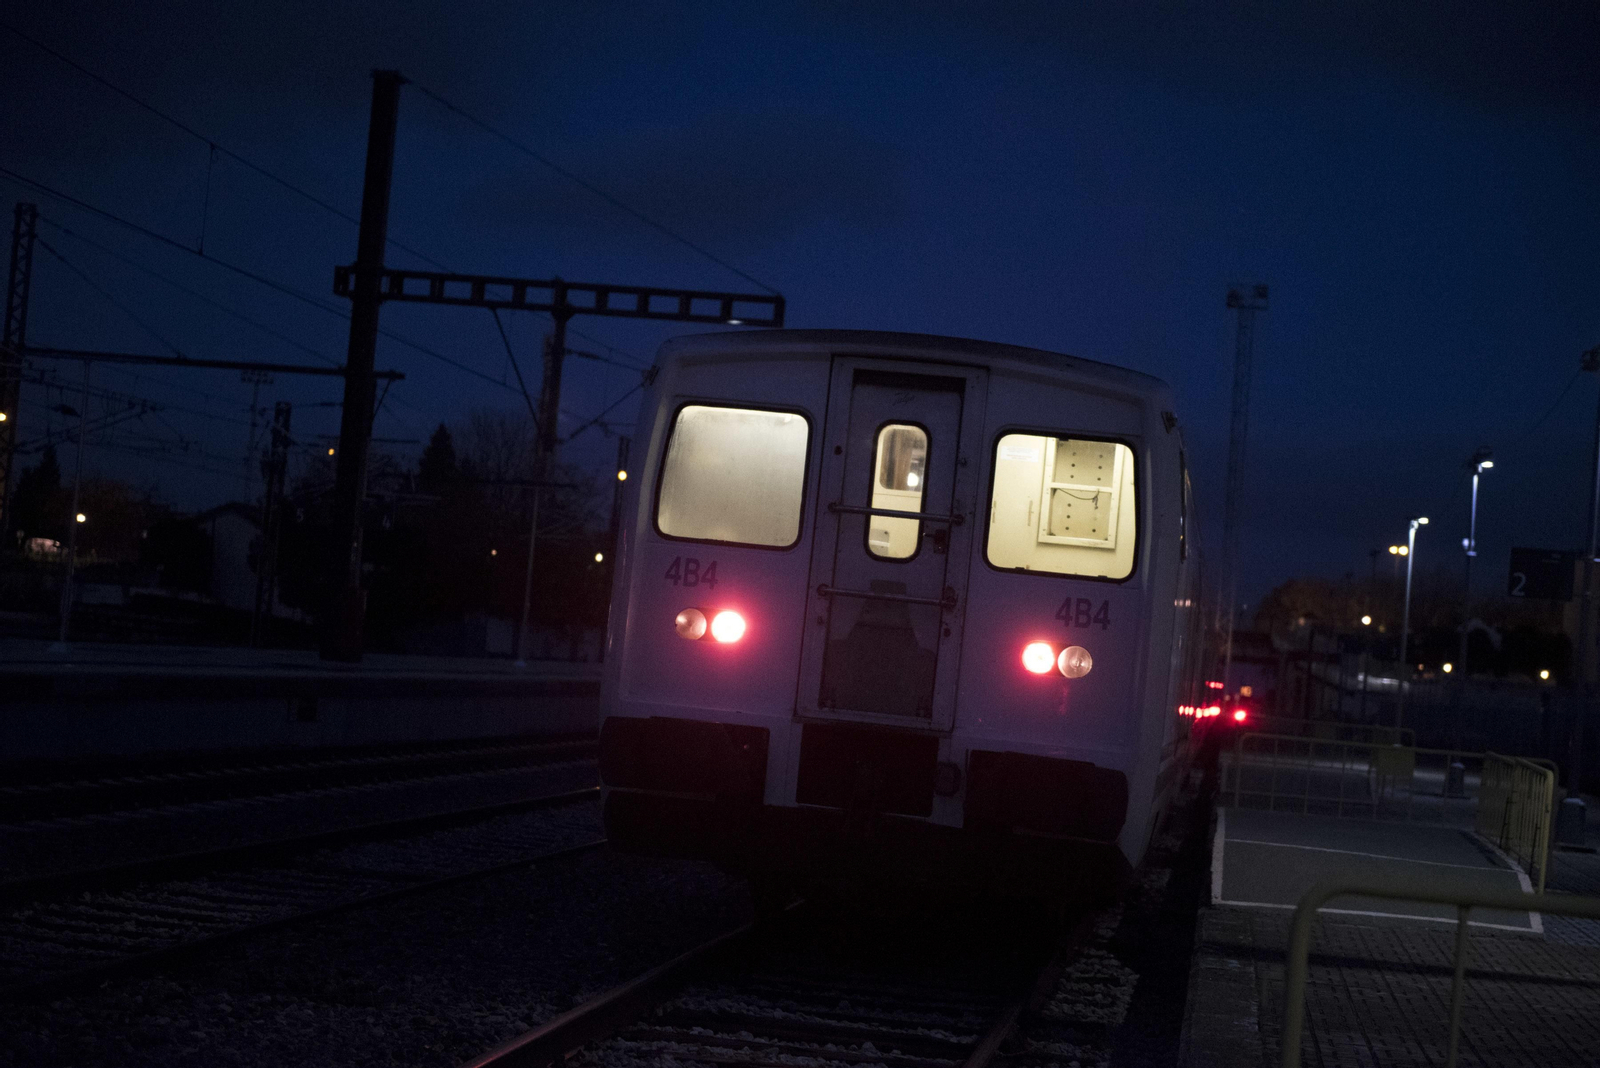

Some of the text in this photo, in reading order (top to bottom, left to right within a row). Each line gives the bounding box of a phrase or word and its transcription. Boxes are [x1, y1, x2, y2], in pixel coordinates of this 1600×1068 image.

[664, 556, 718, 590] 4B4
[1511, 571, 1526, 597] 2
[1055, 596, 1110, 630] 4B4
